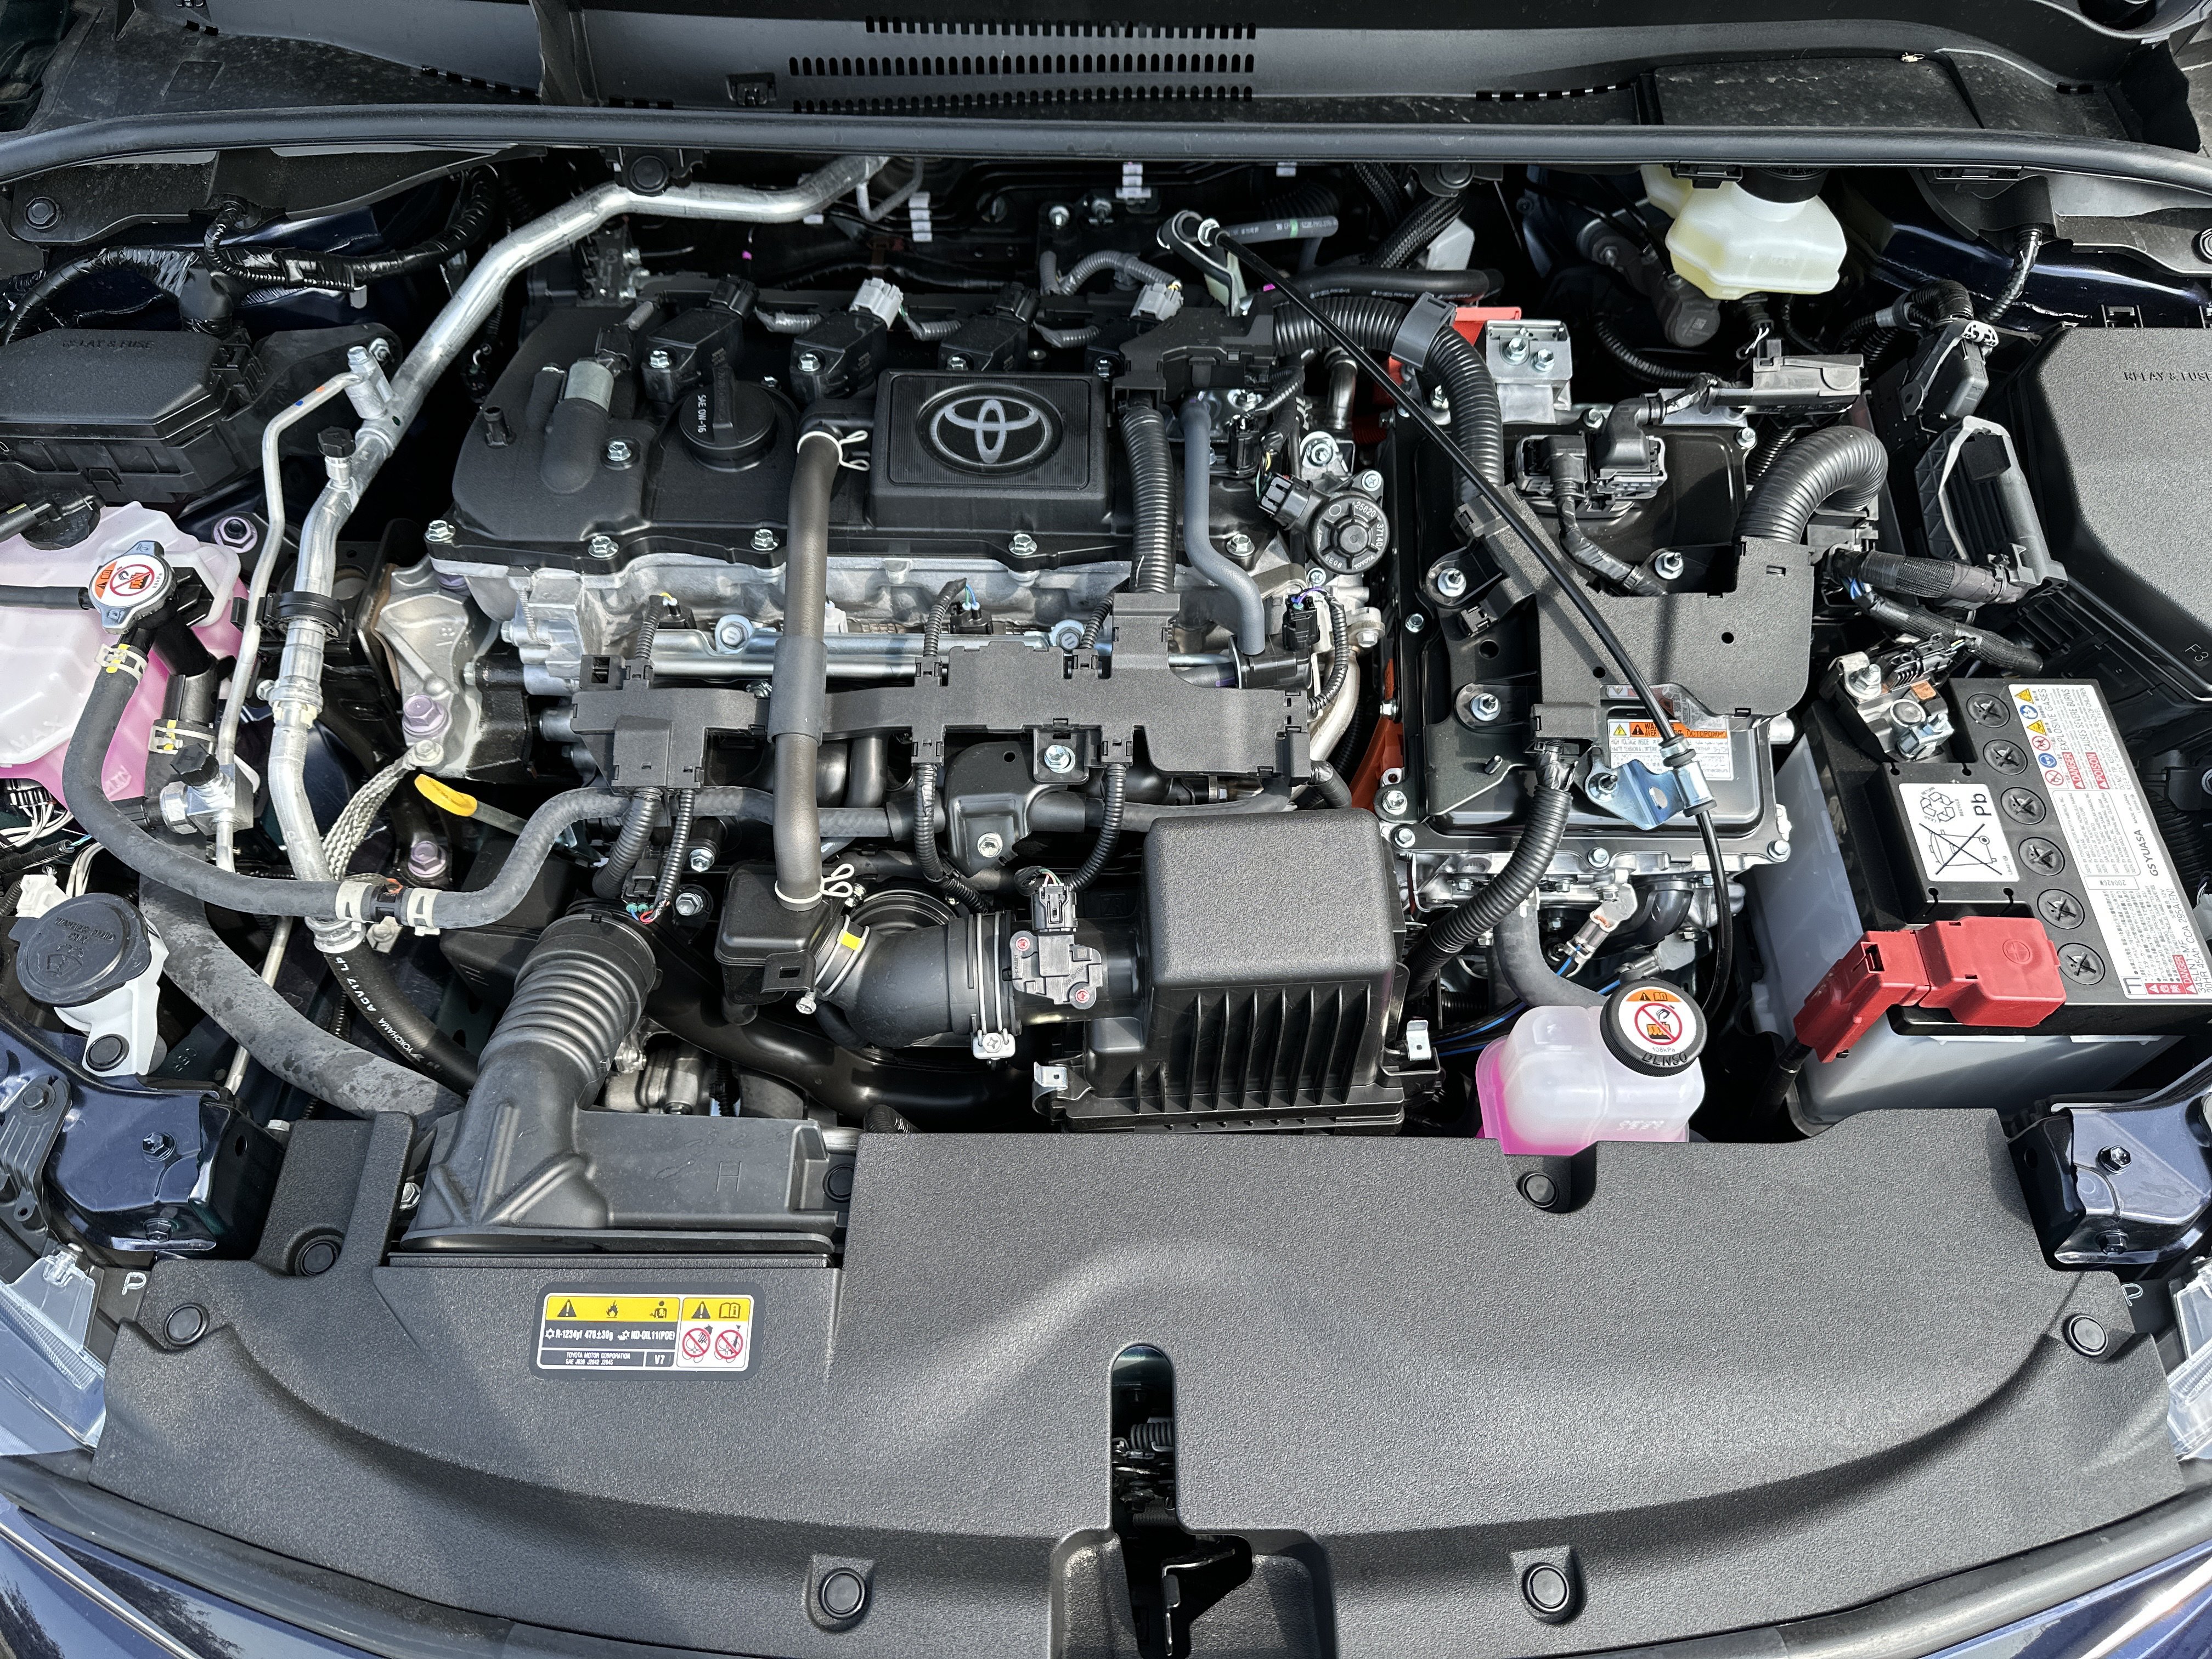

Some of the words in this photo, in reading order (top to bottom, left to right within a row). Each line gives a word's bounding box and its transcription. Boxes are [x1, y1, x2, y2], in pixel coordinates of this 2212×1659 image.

[2124, 371, 2163, 381] RELAY
[2169, 372, 2179, 381] &
[697, 394, 707, 408] SAE
[697, 408, 707, 433] 0W-16
[1354, 501, 1376, 518] 25620
[1375, 523, 1384, 547] 37140
[1353, 554, 1376, 570] TOYOTA
[2184, 643, 2209, 662] F3
[2038, 689, 2053, 710] GASES
[2061, 689, 2075, 706] BURNS
[2068, 708, 2084, 727] SEVERE
[2047, 714, 2069, 750] EXPLOSIVE
[2077, 730, 2093, 751] CAUSES
[2062, 753, 2081, 781] DANGER
[2086, 753, 2106, 781] POISON
[1970, 793, 1993, 816] Pb
[2134, 830, 2152, 862] YUASA
[2147, 864, 2158, 876] GS
[2166, 888, 2186, 922] 295A(EN)
[2181, 925, 2194, 943] CCA
[335, 956, 350, 973] LP
[2178, 940, 2208, 992] 345LN1-MF
[2191, 948, 2204, 968] 45Ah
[2172, 955, 2193, 984] DANGER
[347, 977, 376, 1012] ACV17
[379, 1018, 416, 1054] YOKOHAMA
[1641, 1052, 1688, 1066] DENSO
[715, 1160, 742, 1193] H
[121, 1271, 148, 1296] P
[555, 1329, 583, 1340] R-1234yf
[584, 1330, 613, 1341] 470±30g
[631, 1330, 675, 1340] ND-OIL11(POE)
[654, 1355, 665, 1365] V7
